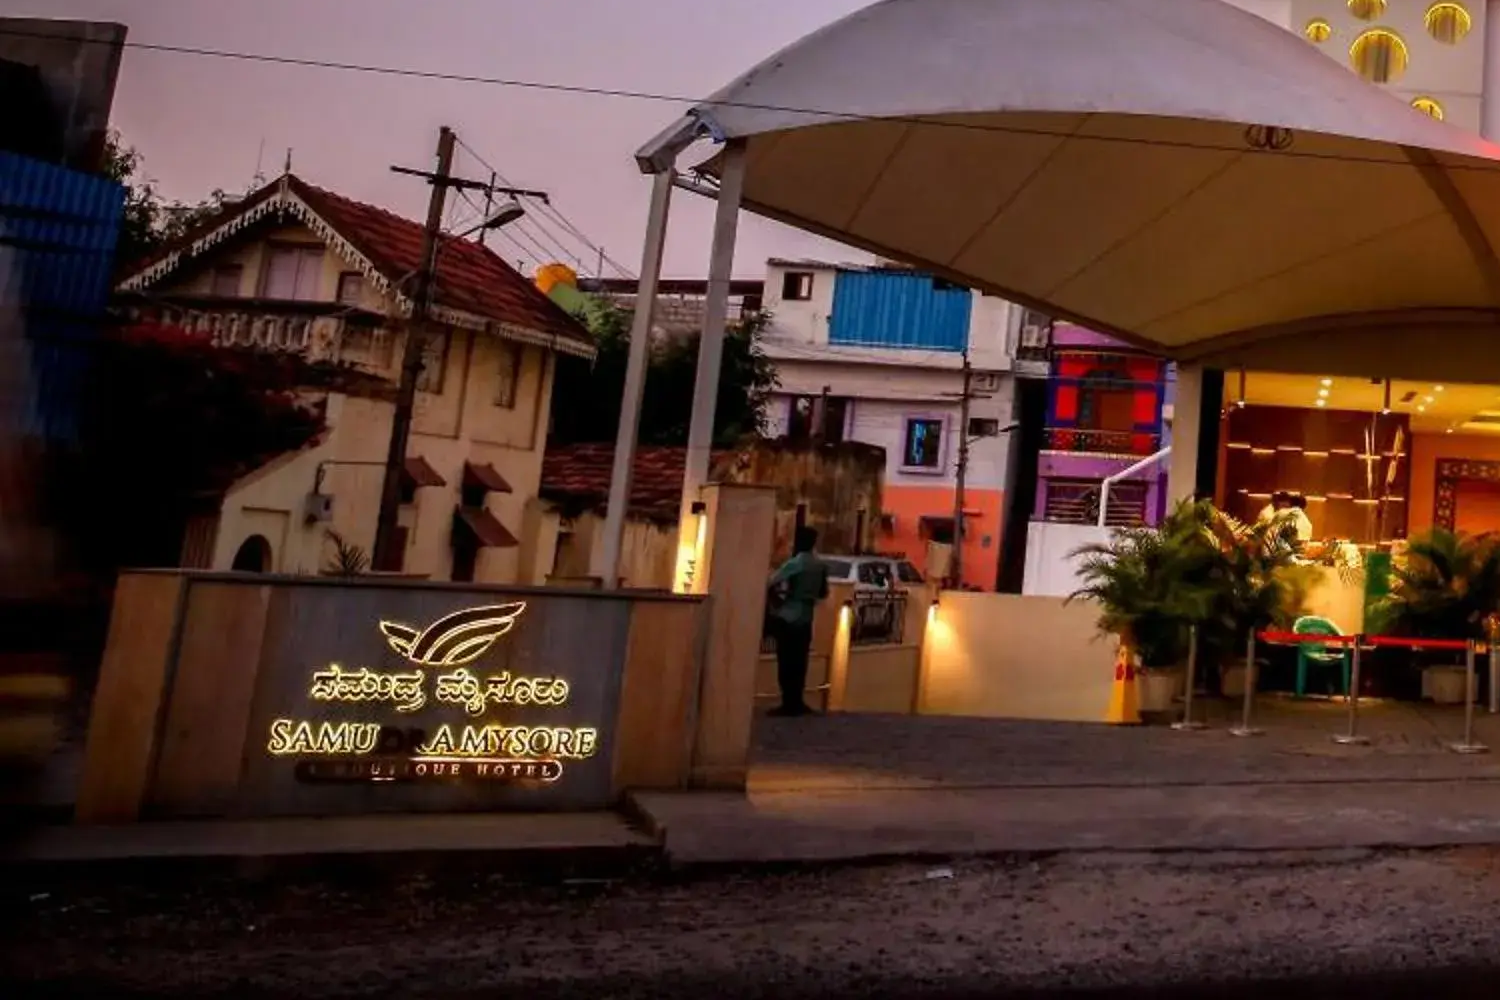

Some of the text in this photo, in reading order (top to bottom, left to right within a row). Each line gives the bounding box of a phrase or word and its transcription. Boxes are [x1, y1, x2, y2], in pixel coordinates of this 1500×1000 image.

[311, 664, 427, 711] ಸಮುದ್ರ
[460, 724, 597, 758] MYSORE
[477, 763, 552, 777] HOTEL
